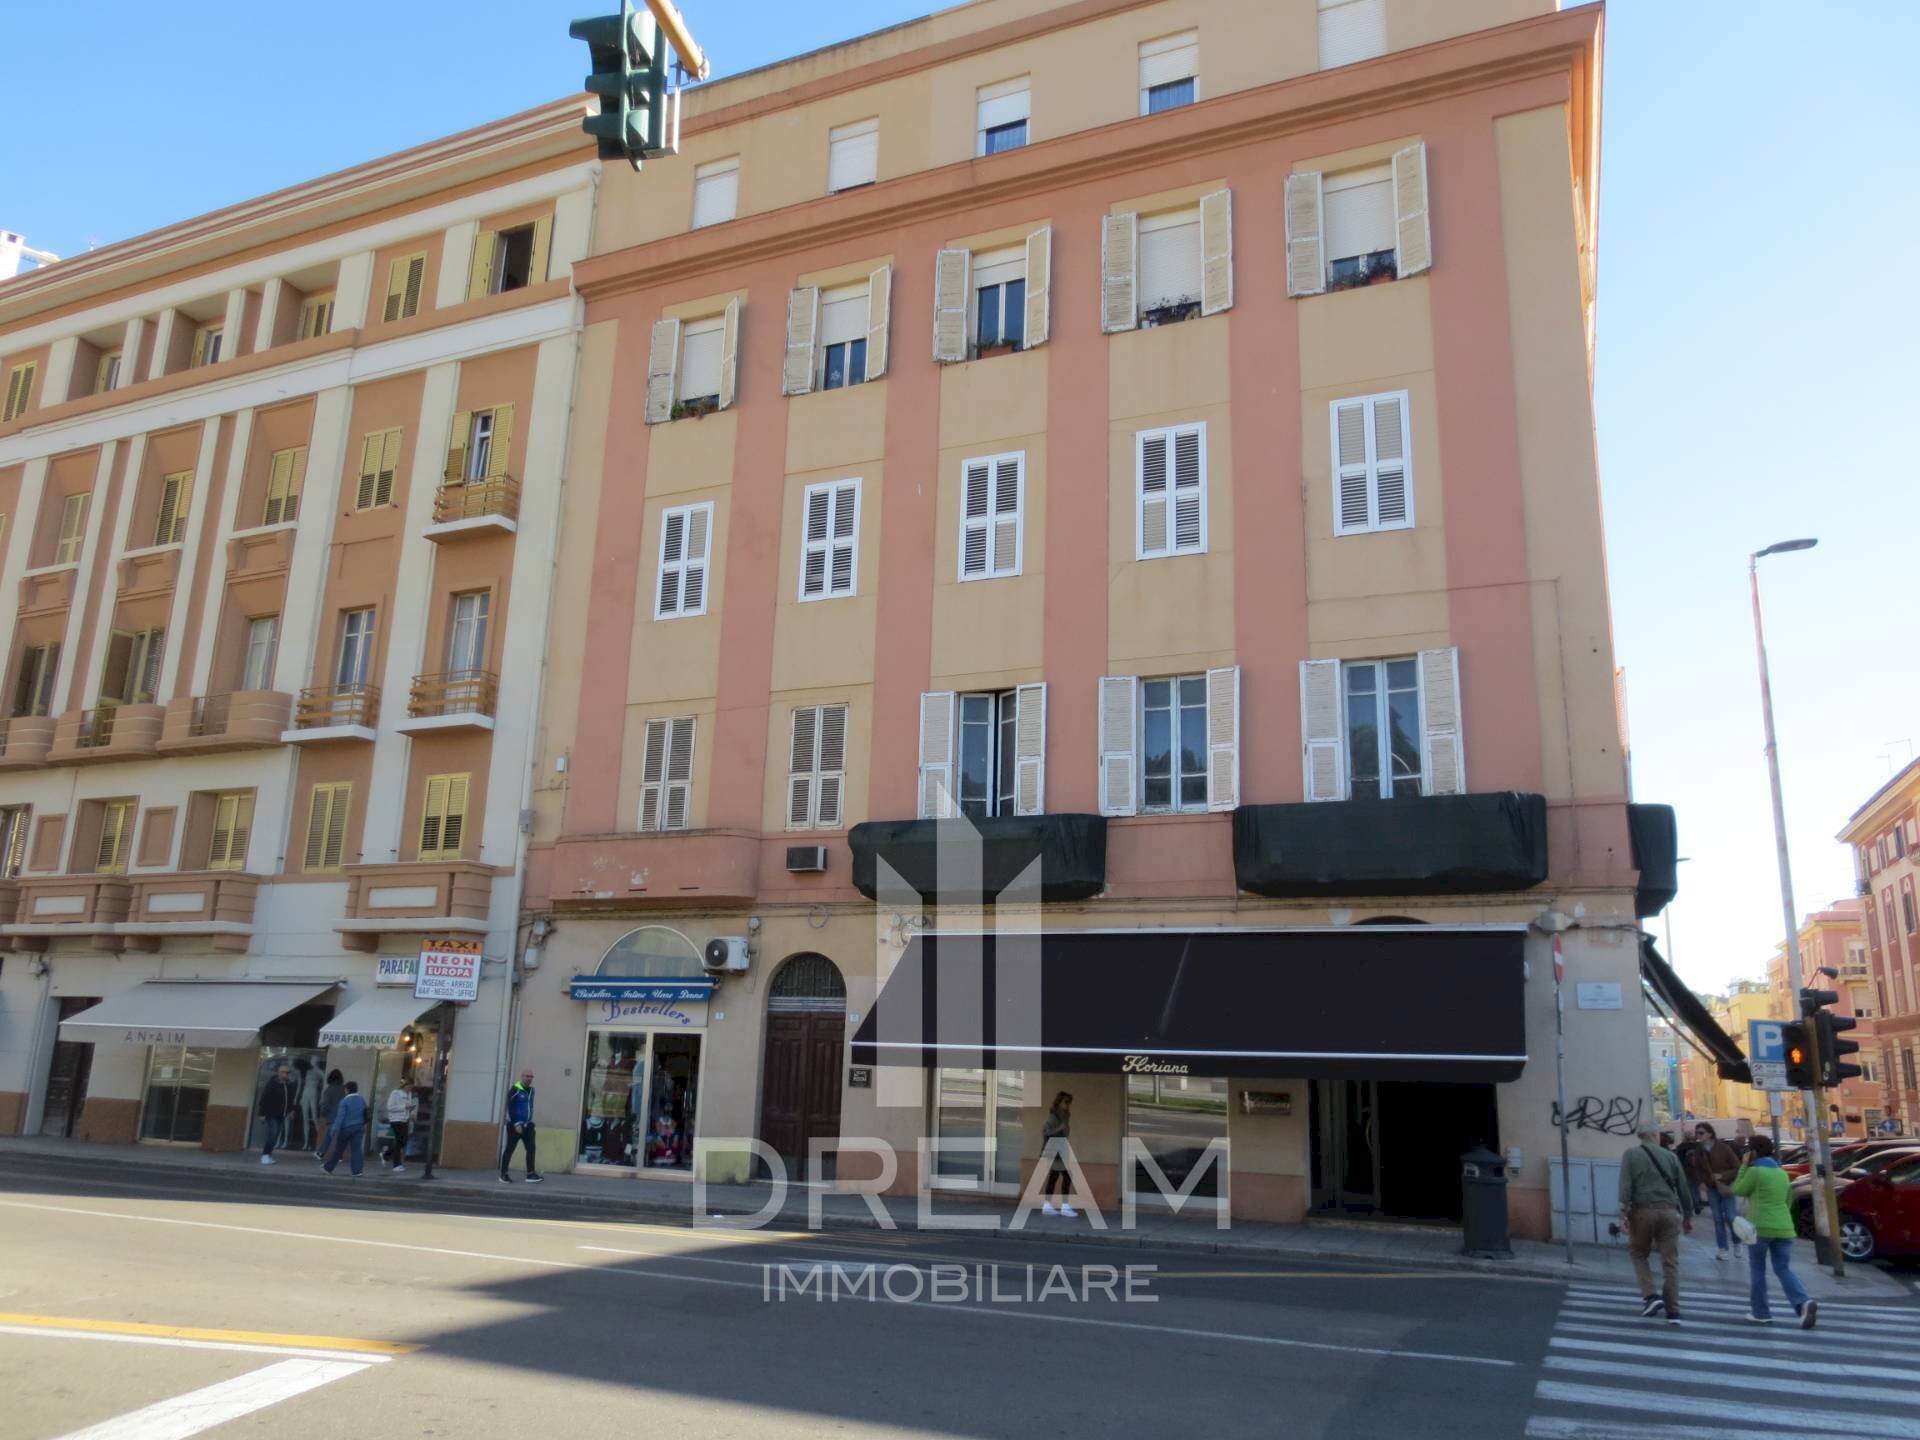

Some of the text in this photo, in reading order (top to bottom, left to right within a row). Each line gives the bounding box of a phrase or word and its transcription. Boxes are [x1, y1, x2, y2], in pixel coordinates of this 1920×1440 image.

[428, 940, 478, 949] TAXI
[426, 955, 475, 966] NEON
[428, 966, 470, 977] EUROPA
[602, 999, 691, 1025] Bestsellers
[322, 1033, 396, 1045] PARAFARMACIA
[1757, 1024, 1784, 1057] P
[1122, 1055, 1189, 1074] Floriana
